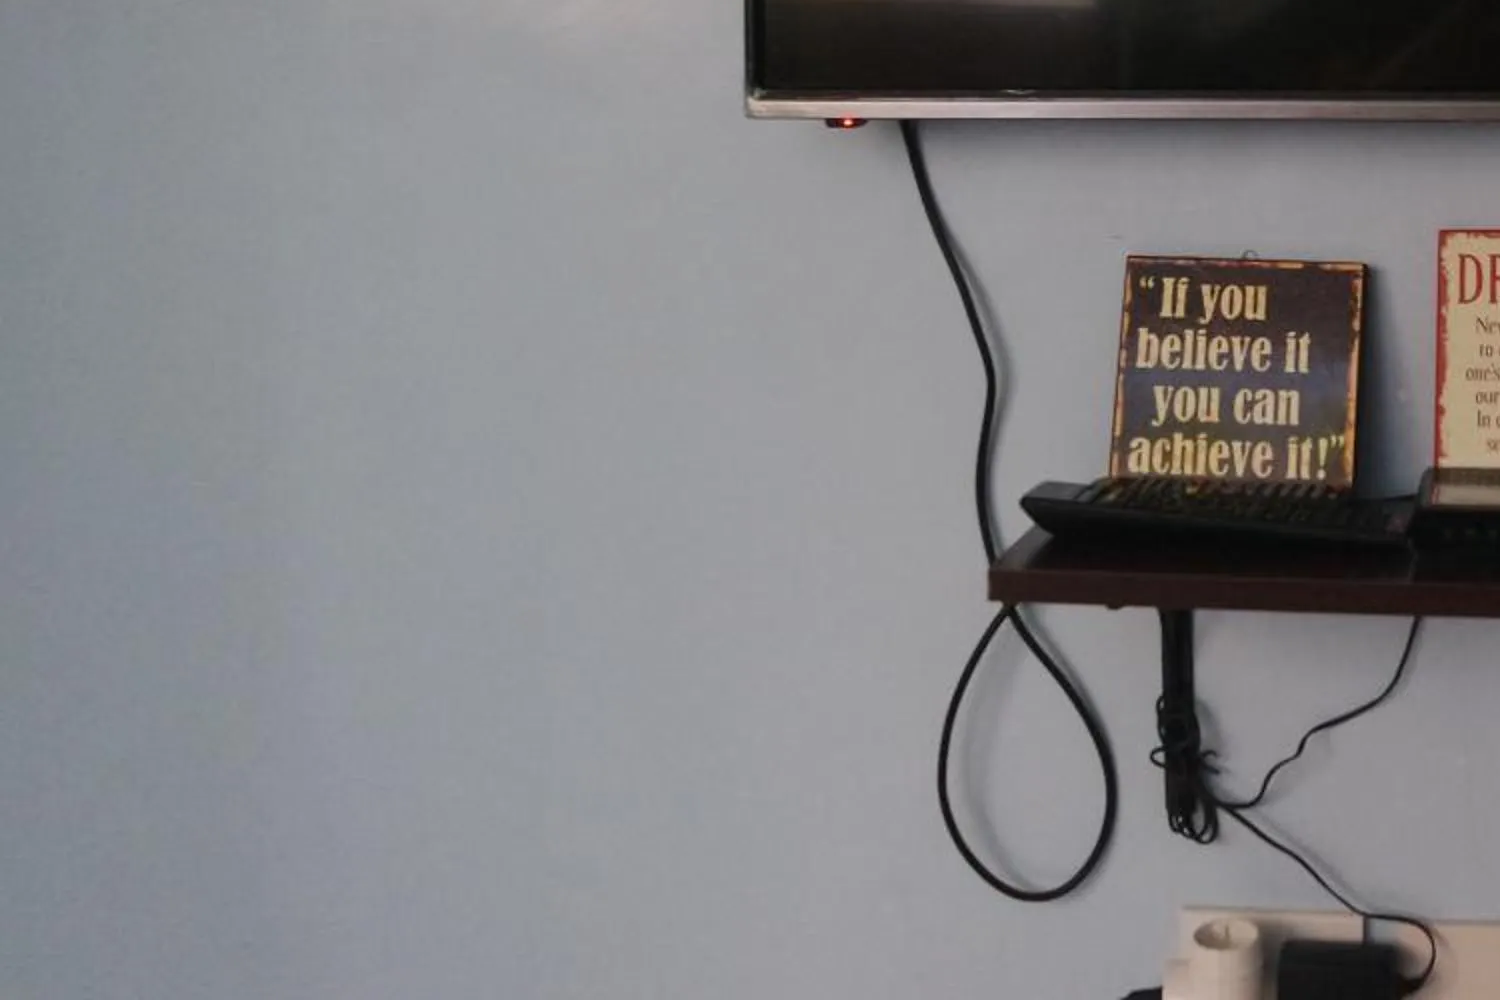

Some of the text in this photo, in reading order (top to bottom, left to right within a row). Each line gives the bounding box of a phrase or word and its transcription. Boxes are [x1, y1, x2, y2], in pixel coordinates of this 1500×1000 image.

[1198, 284, 1267, 324] you
[1135, 327, 1311, 373] believe it
[1479, 344, 1493, 358] to
[1152, 385, 1300, 427] you can
[1475, 391, 1499, 404] our
[1477, 411, 1491, 427] In
[1127, 432, 1274, 478] achieve
